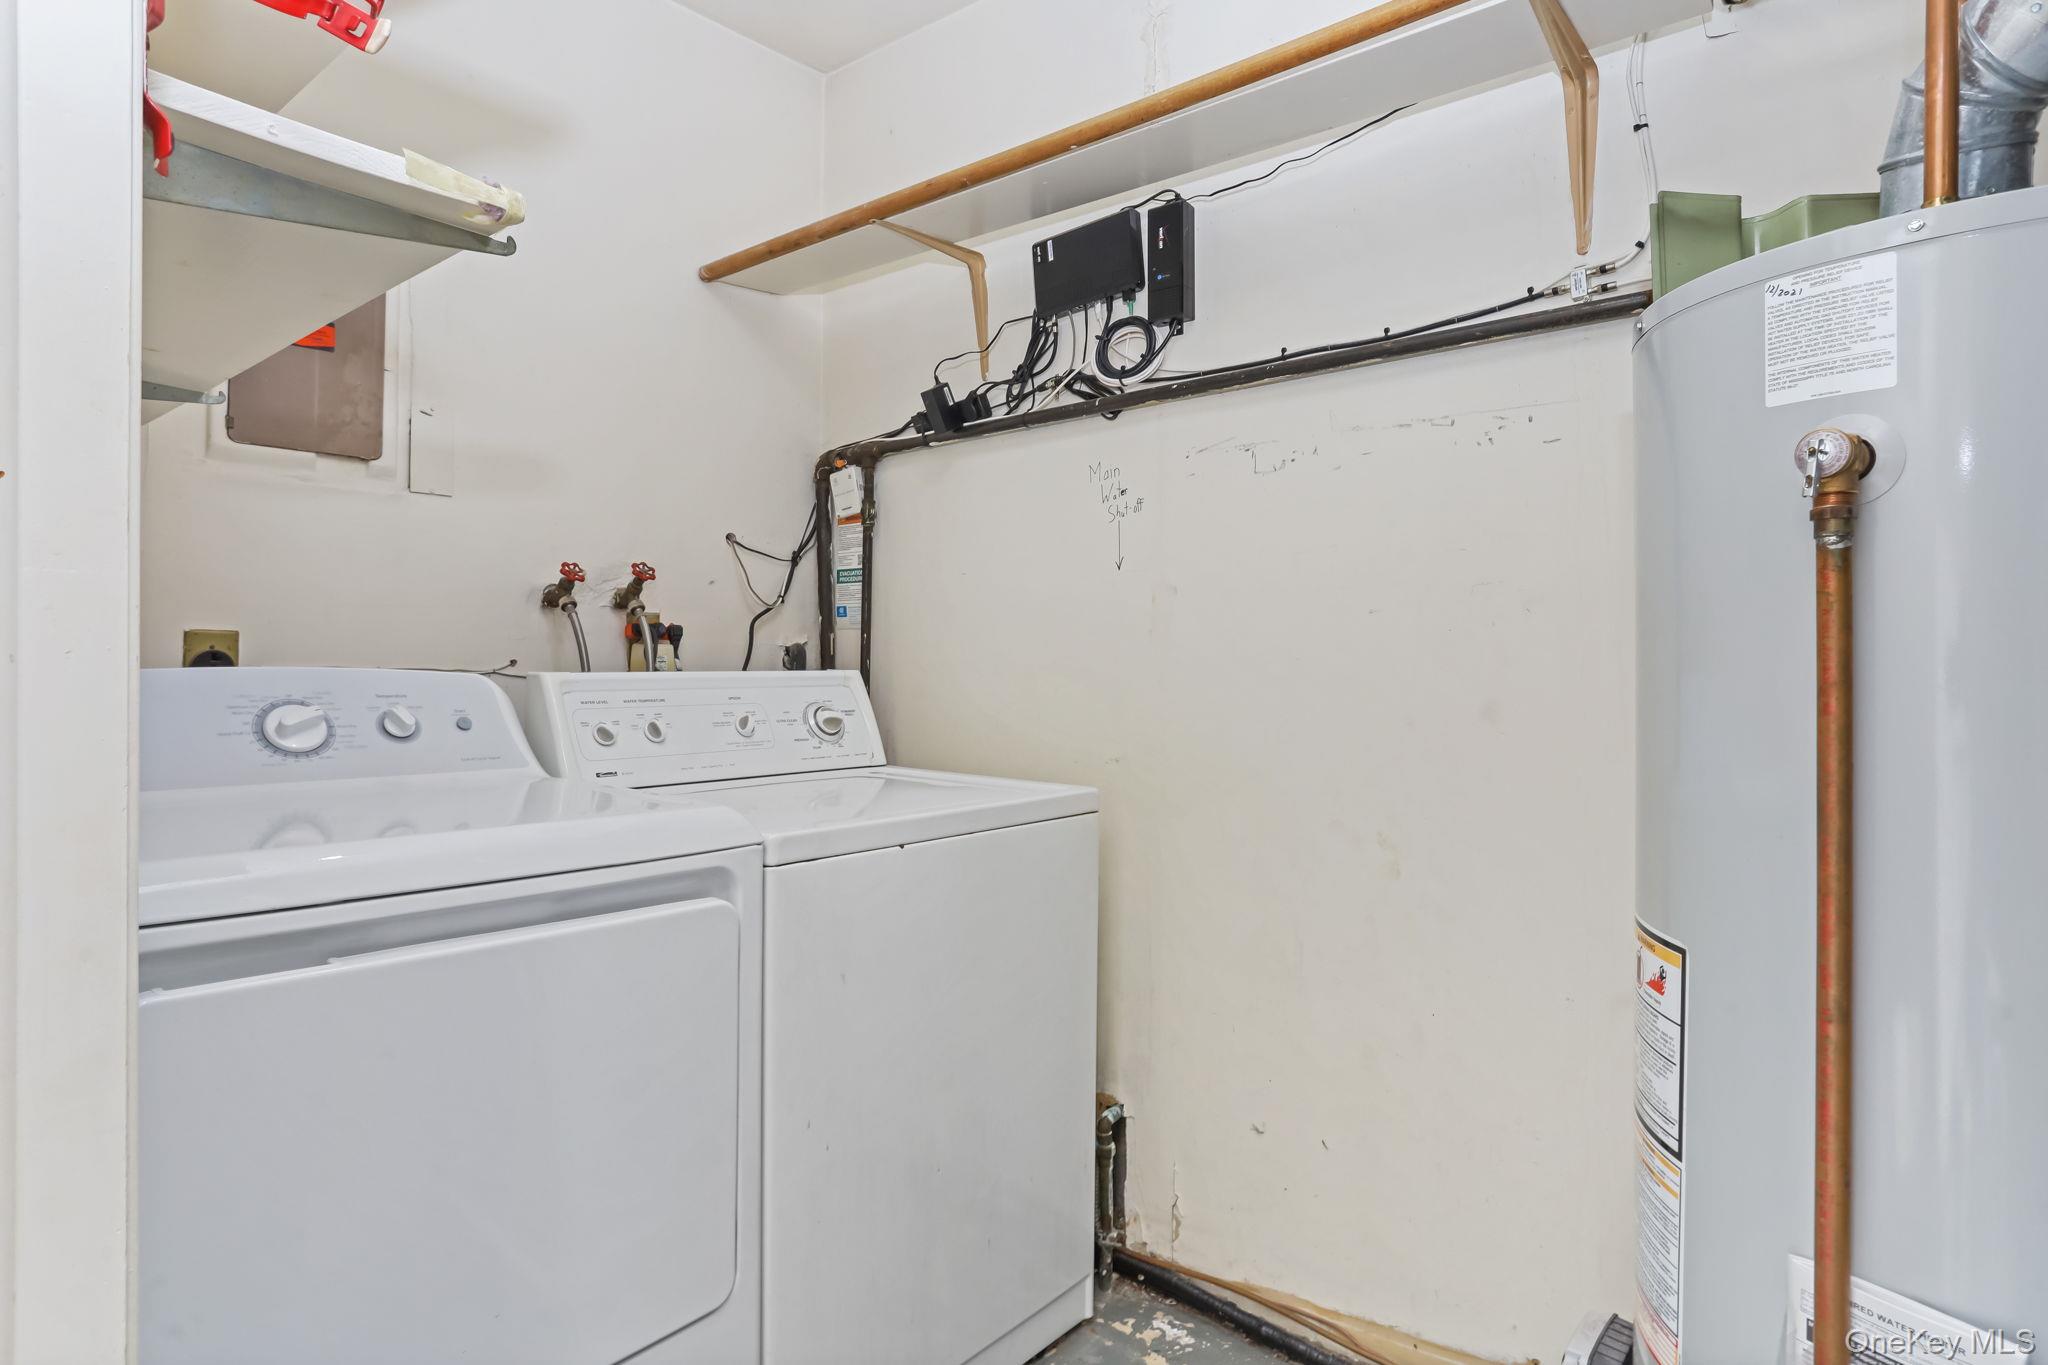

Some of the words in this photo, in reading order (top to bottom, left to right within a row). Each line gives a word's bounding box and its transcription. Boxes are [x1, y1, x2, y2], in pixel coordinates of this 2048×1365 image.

[1766, 284, 1802, 297] 12/2021
[1089, 461, 1120, 482] Main
[1101, 480, 1127, 504] Water
